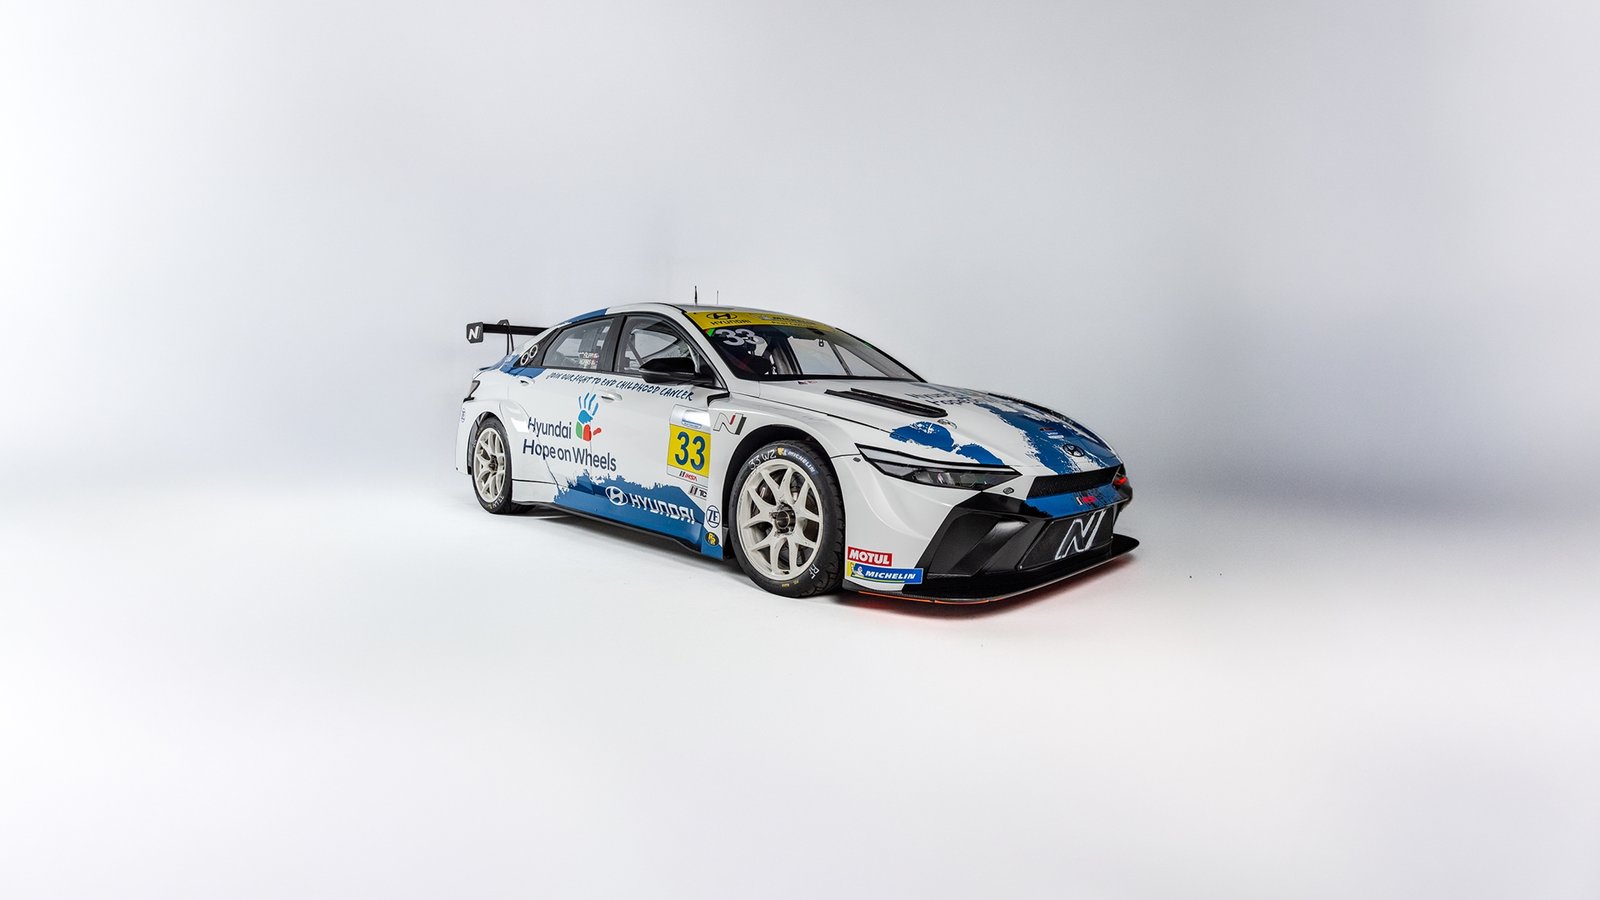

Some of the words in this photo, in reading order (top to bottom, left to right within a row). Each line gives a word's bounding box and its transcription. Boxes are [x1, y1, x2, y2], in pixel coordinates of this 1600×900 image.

[468, 325, 480, 340] N
[714, 328, 765, 347] 33
[601, 377, 615, 387] END
[615, 380, 661, 395] CHILDHOOD
[659, 387, 695, 402] CANCER
[527, 416, 572, 439] Hyundai
[522, 438, 556, 460] Hope
[557, 447, 572, 462] on
[572, 446, 617, 472] Wheels
[674, 431, 706, 471] 33
[748, 454, 761, 471] 33
[629, 493, 695, 525] HYUNDAI
[1054, 508, 1107, 561] N
[848, 548, 890, 566] MOTUL
[865, 570, 916, 580] MICHELIN
